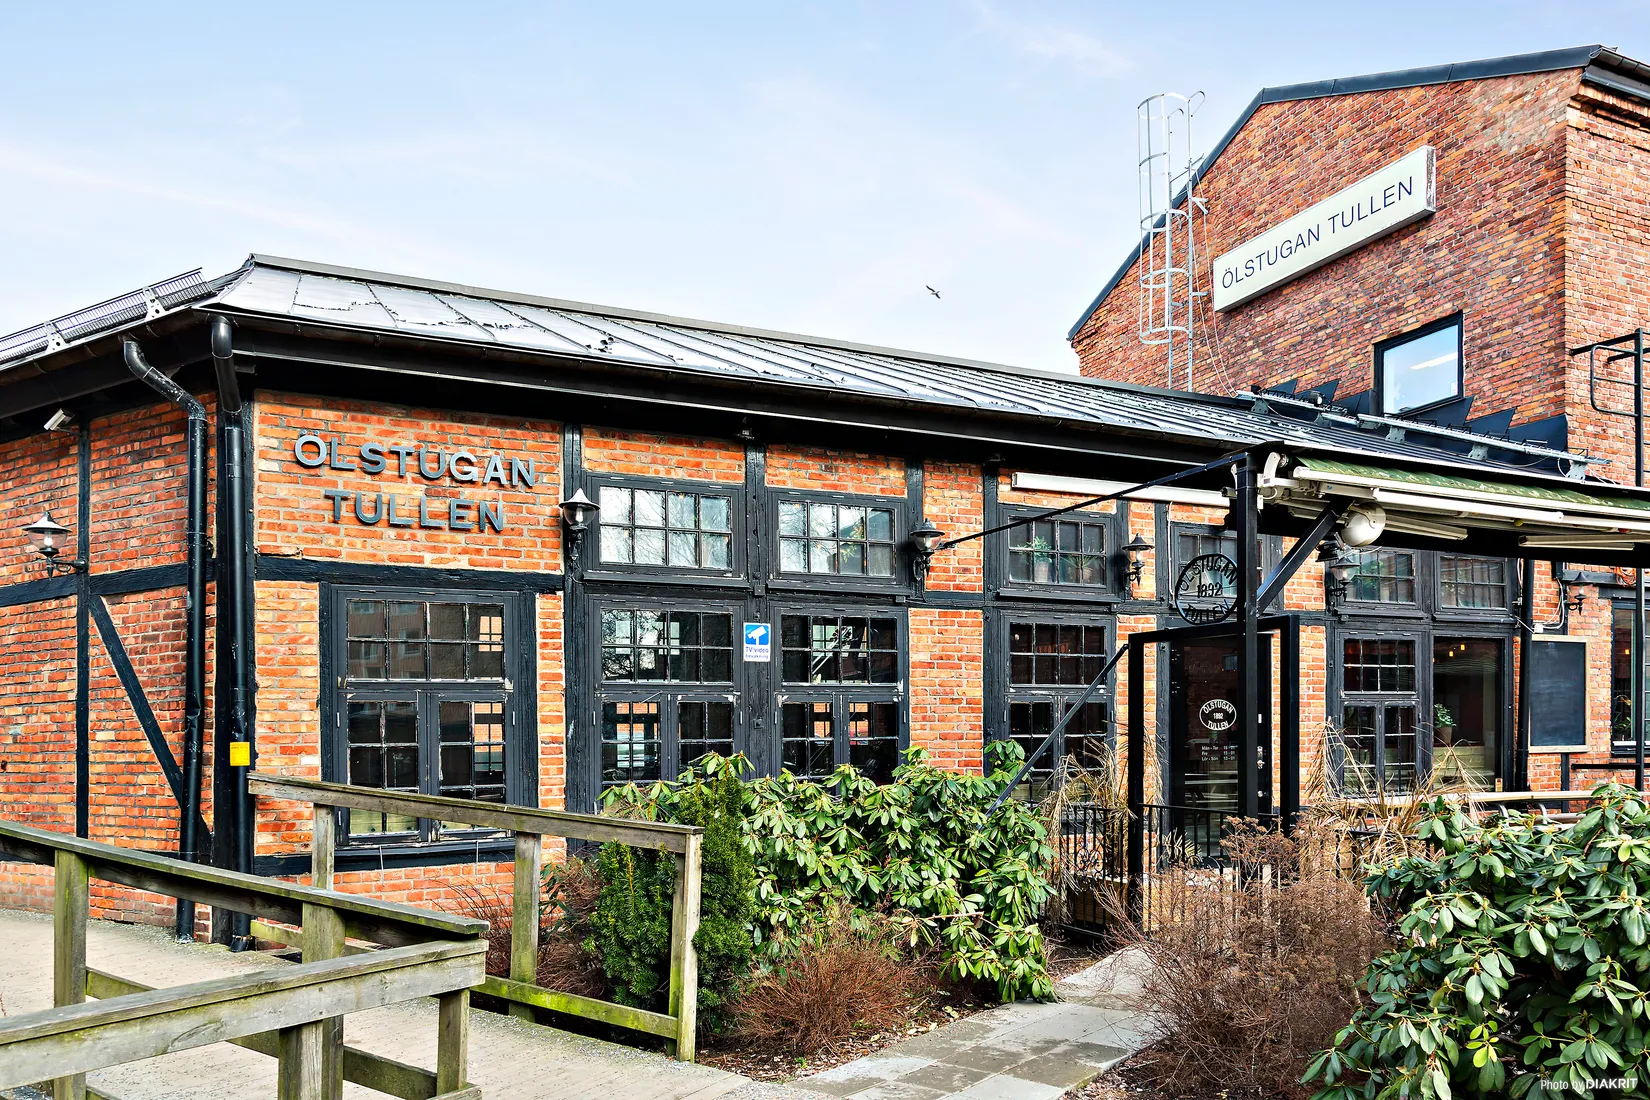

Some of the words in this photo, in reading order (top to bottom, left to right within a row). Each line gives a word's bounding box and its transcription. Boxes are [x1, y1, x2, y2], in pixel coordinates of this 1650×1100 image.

[1221, 223, 1321, 289] ÖLSTUGAN
[1327, 176, 1413, 234] TULLEN
[294, 429, 536, 488] ÖLSTUGAN
[324, 488, 504, 532] TULLEN
[1208, 720, 1228, 729] TULLEN
